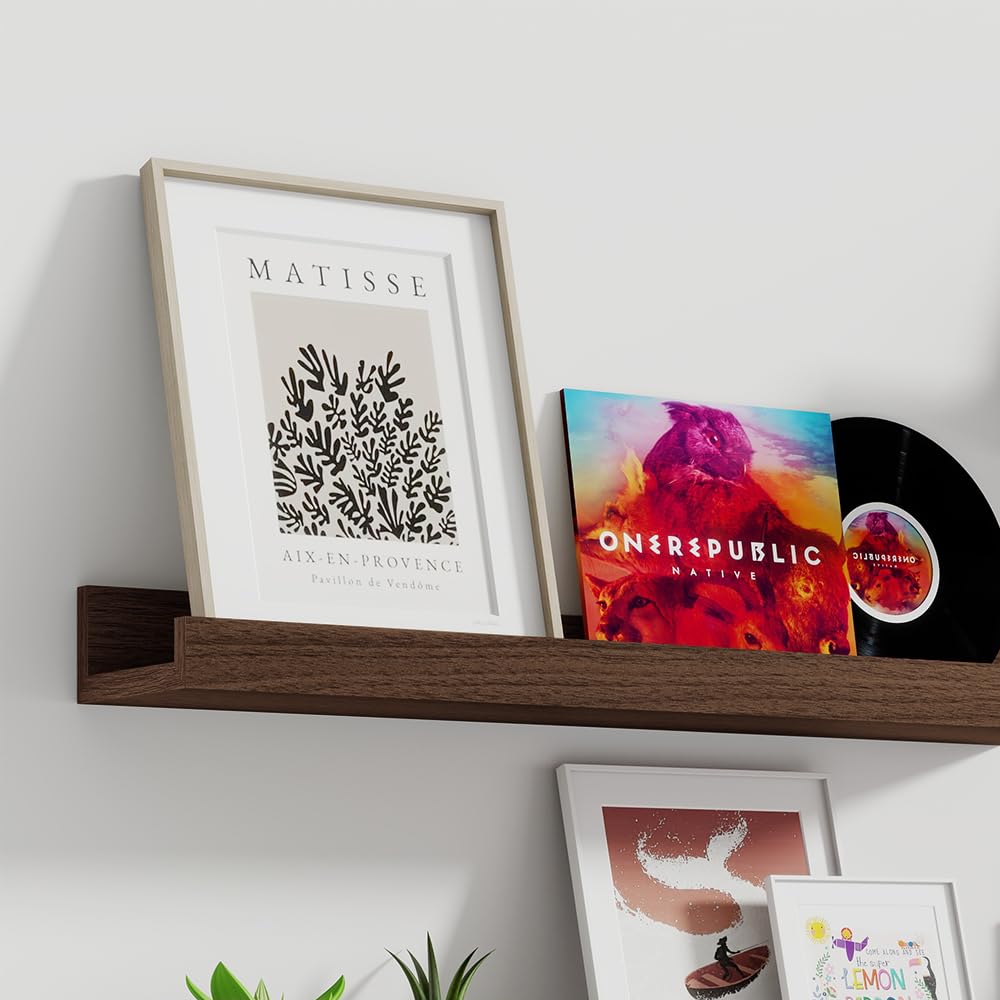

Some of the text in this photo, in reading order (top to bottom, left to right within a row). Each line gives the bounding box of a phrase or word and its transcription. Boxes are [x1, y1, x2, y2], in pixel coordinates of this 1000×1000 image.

[247, 257, 428, 298] MATISSE
[599, 531, 822, 567] ONEREPUBLIC
[282, 550, 464, 573] AIX-EN-PROVENCE
[311, 574, 441, 591] Pavillon de Vendôme
[672, 566, 757, 581] NATIVE
[842, 967, 907, 991] LEMON
